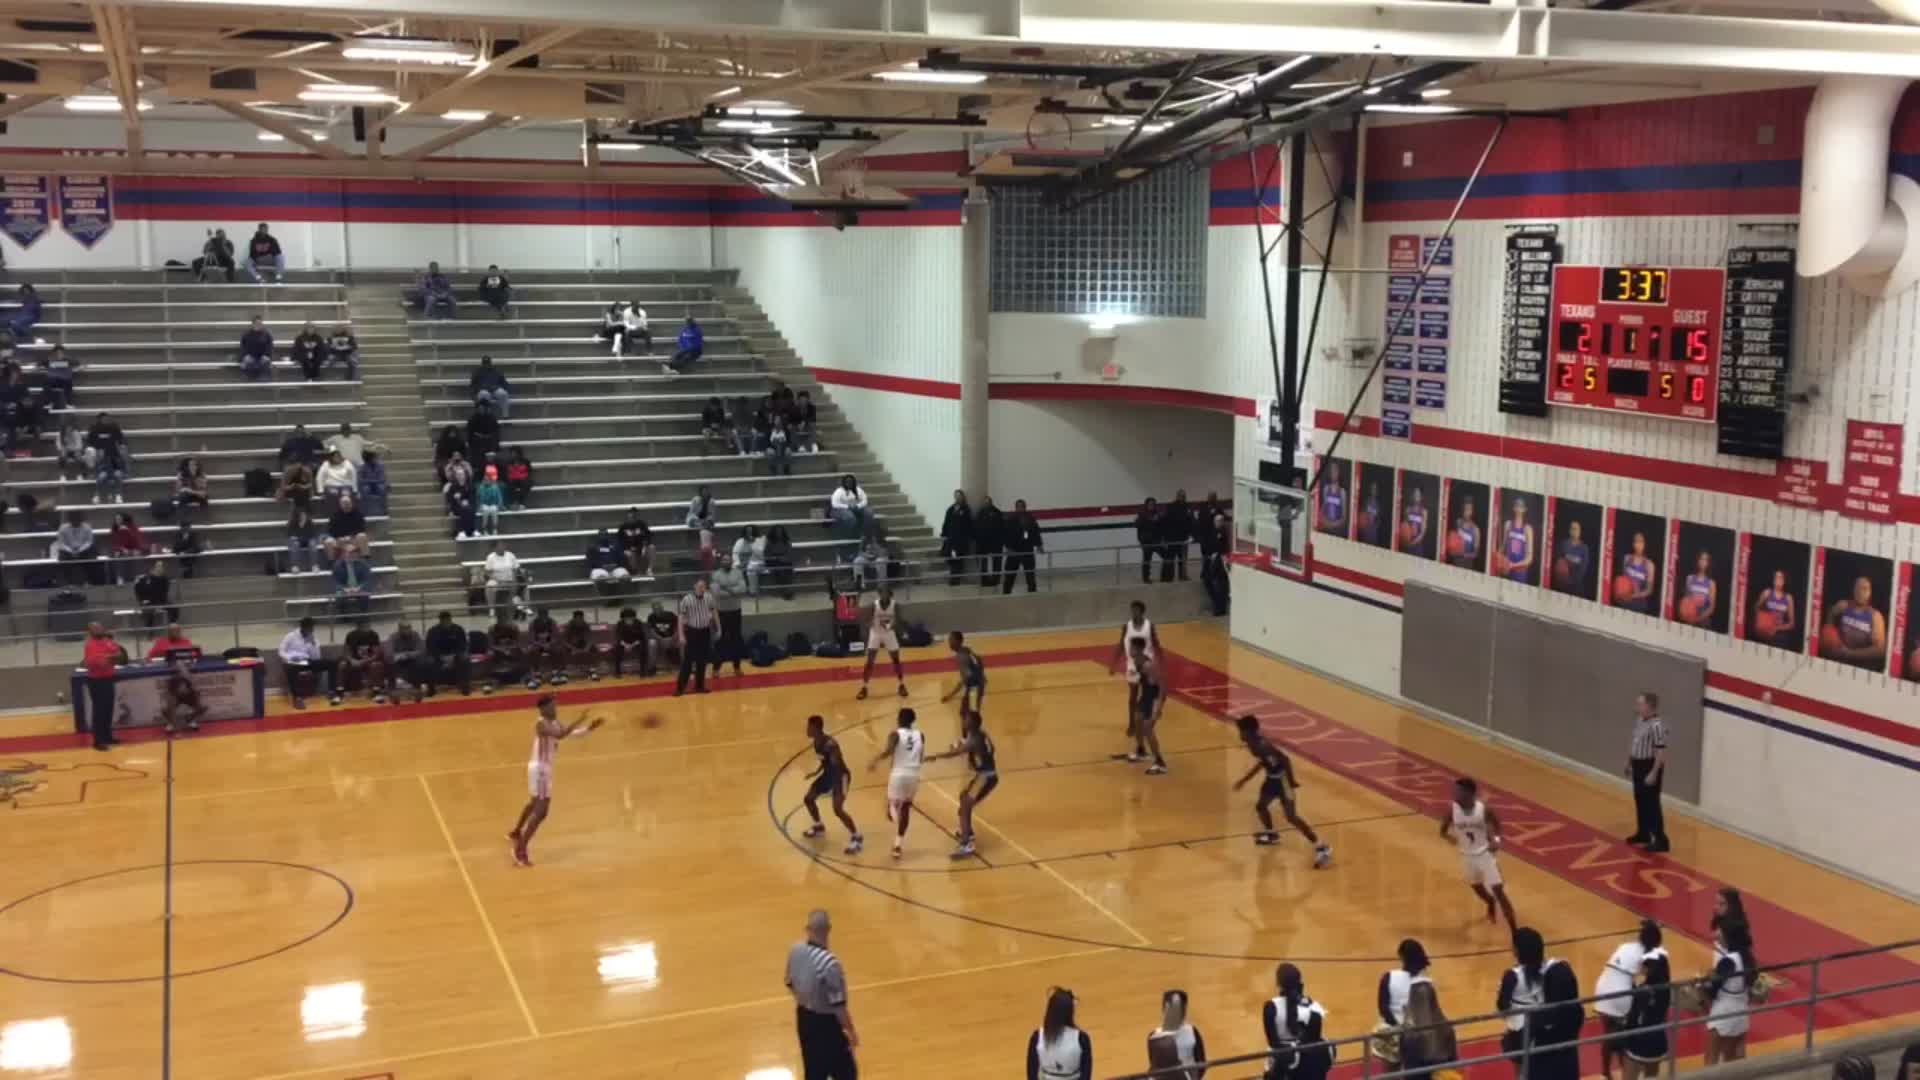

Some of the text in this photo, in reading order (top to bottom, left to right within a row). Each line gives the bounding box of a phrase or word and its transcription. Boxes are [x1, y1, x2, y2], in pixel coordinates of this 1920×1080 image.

[1617, 270, 1666, 300] 3:37
[1560, 304, 1596, 318] TEXANS
[1673, 310, 1709, 324] GUEST
[1577, 323, 1591, 351] 2
[1686, 330, 1707, 361] 15
[1561, 365, 1573, 387] 2
[1583, 367, 1595, 390] 5
[1661, 373, 1673, 398] 5
[1692, 377, 1704, 402] 0
